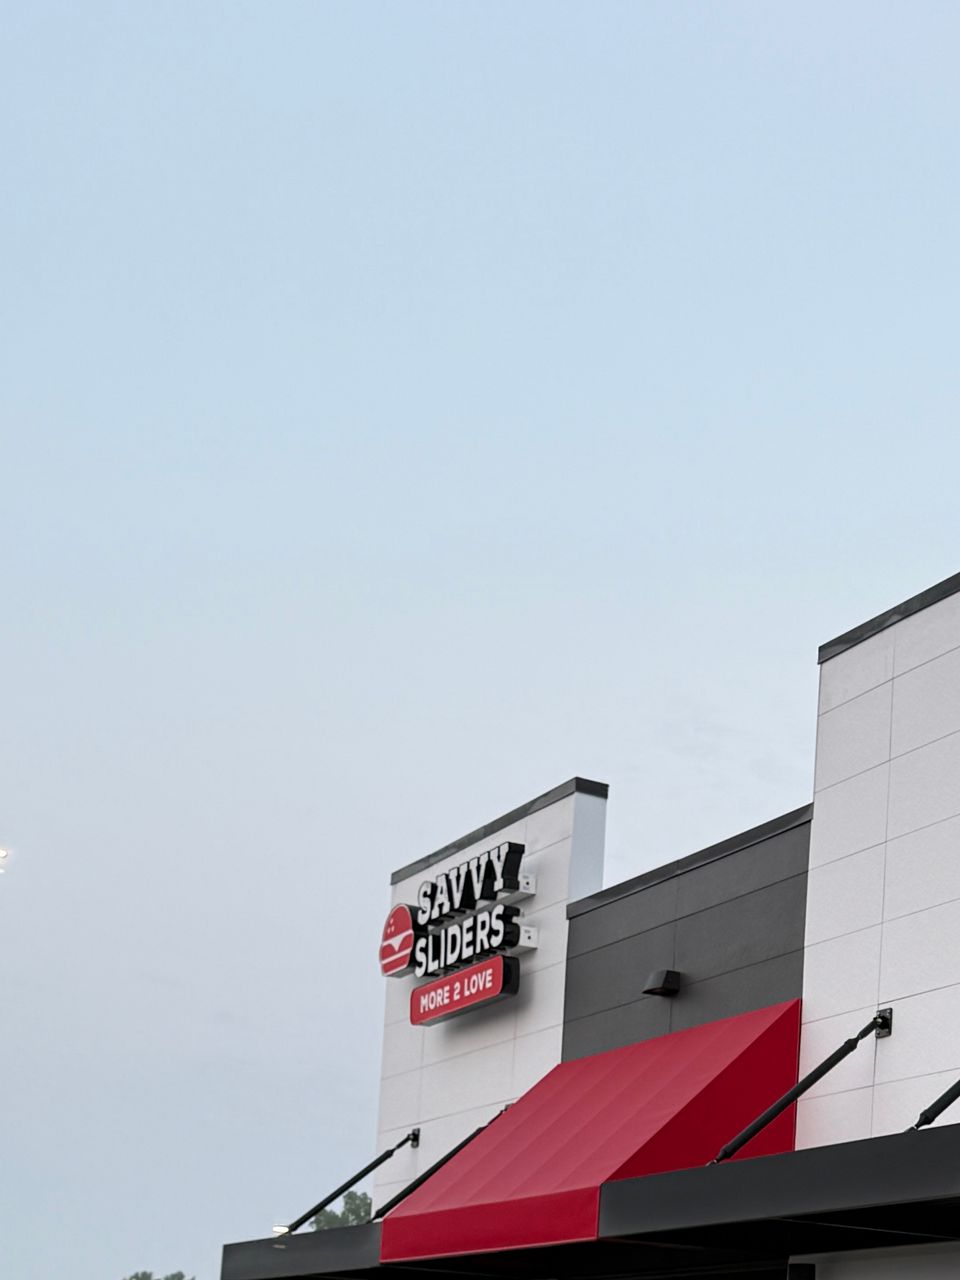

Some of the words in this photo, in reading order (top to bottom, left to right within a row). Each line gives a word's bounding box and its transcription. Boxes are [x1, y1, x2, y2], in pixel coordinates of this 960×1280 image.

[417, 841, 510, 925] SAVVY
[414, 903, 505, 978] SLIDERS
[419, 985, 450, 1013] MORE
[453, 981, 461, 1000] 2
[464, 968, 493, 997] LOVE
